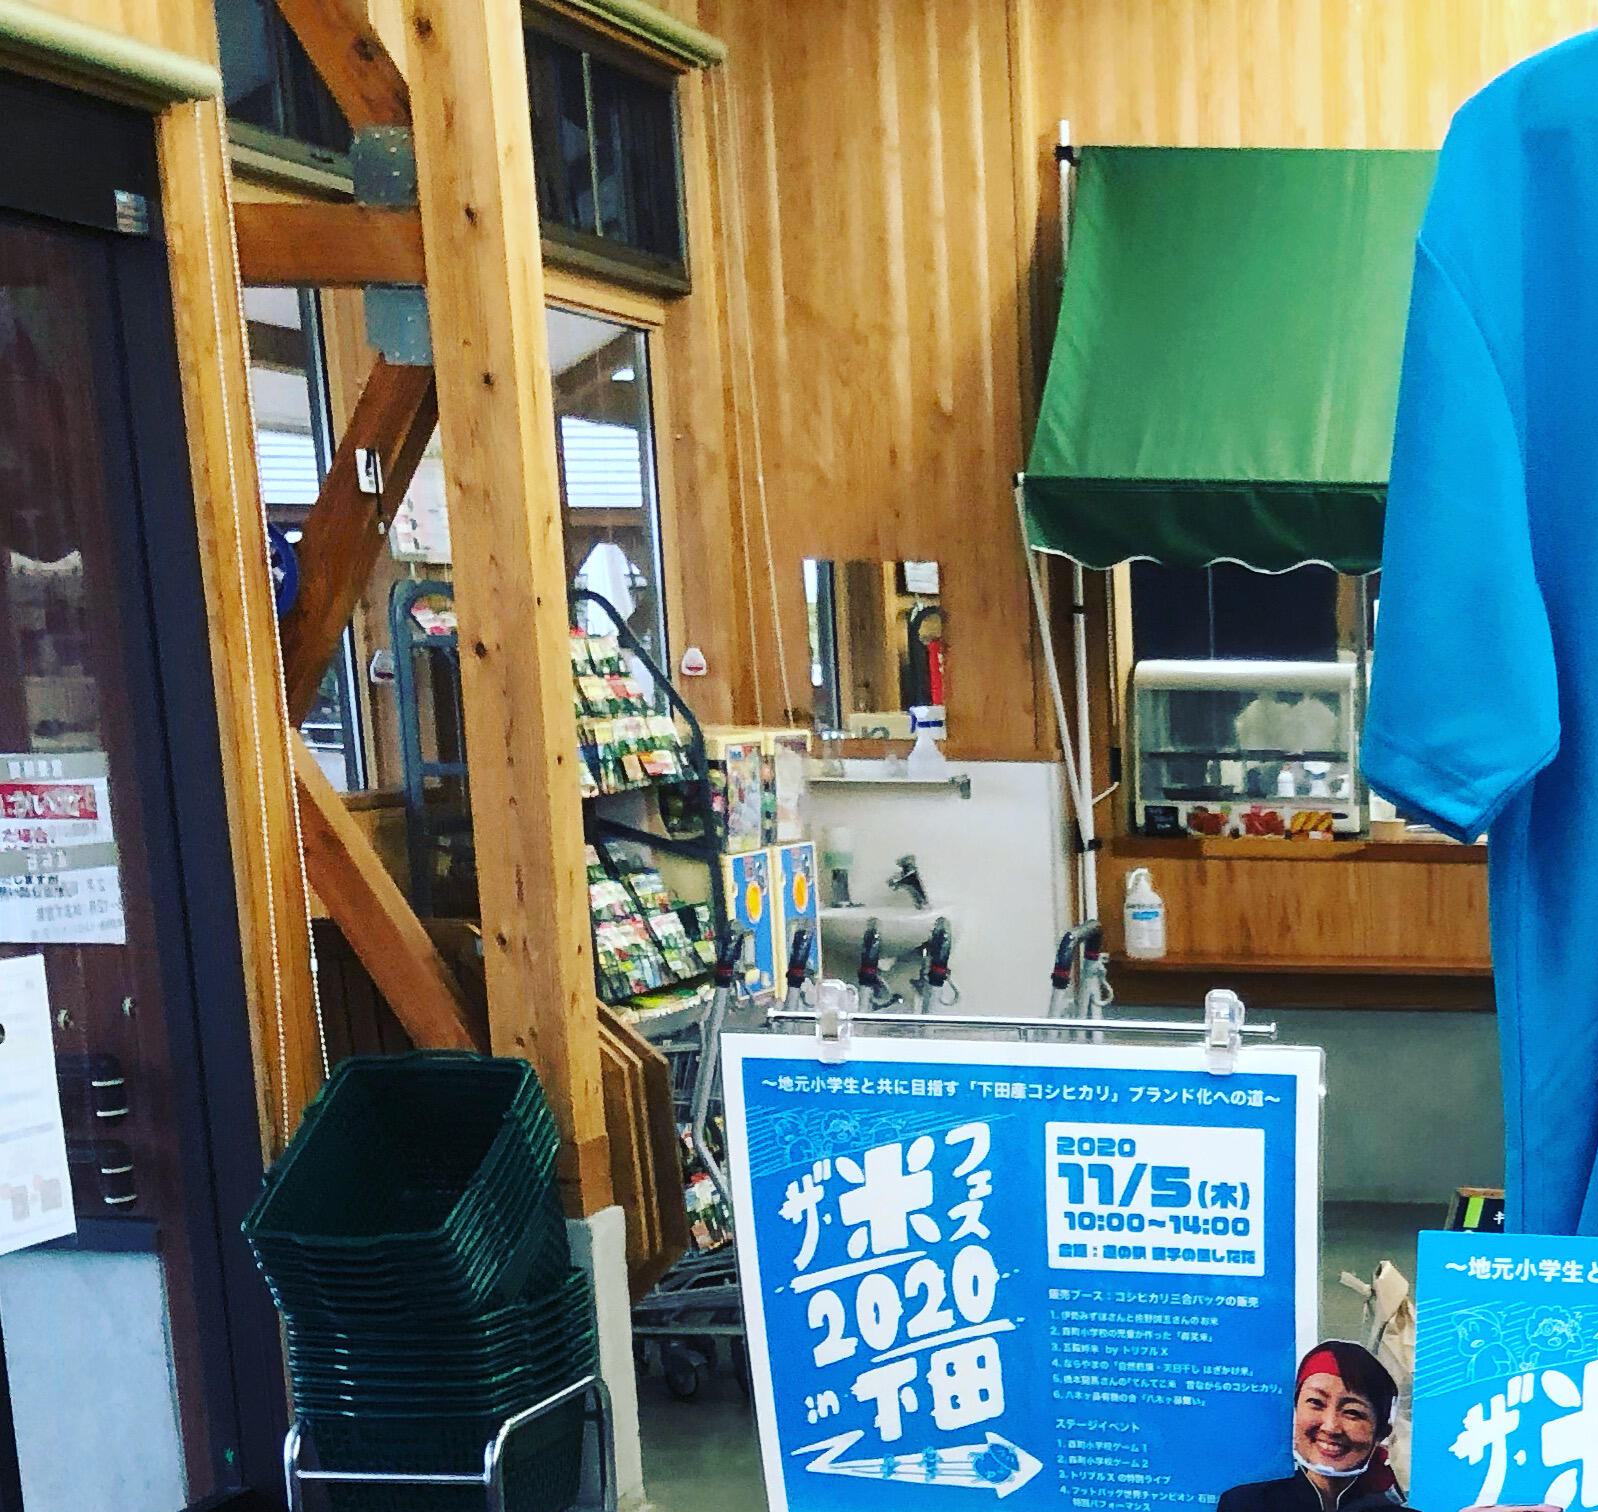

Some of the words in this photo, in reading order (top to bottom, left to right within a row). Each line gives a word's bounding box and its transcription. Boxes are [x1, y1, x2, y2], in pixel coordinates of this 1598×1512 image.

[1056, 1137, 1136, 1158] 2020
[808, 1244, 998, 1367] 2020
[805, 1386, 839, 1424] in
[848, 1336, 1003, 1442] 下田
